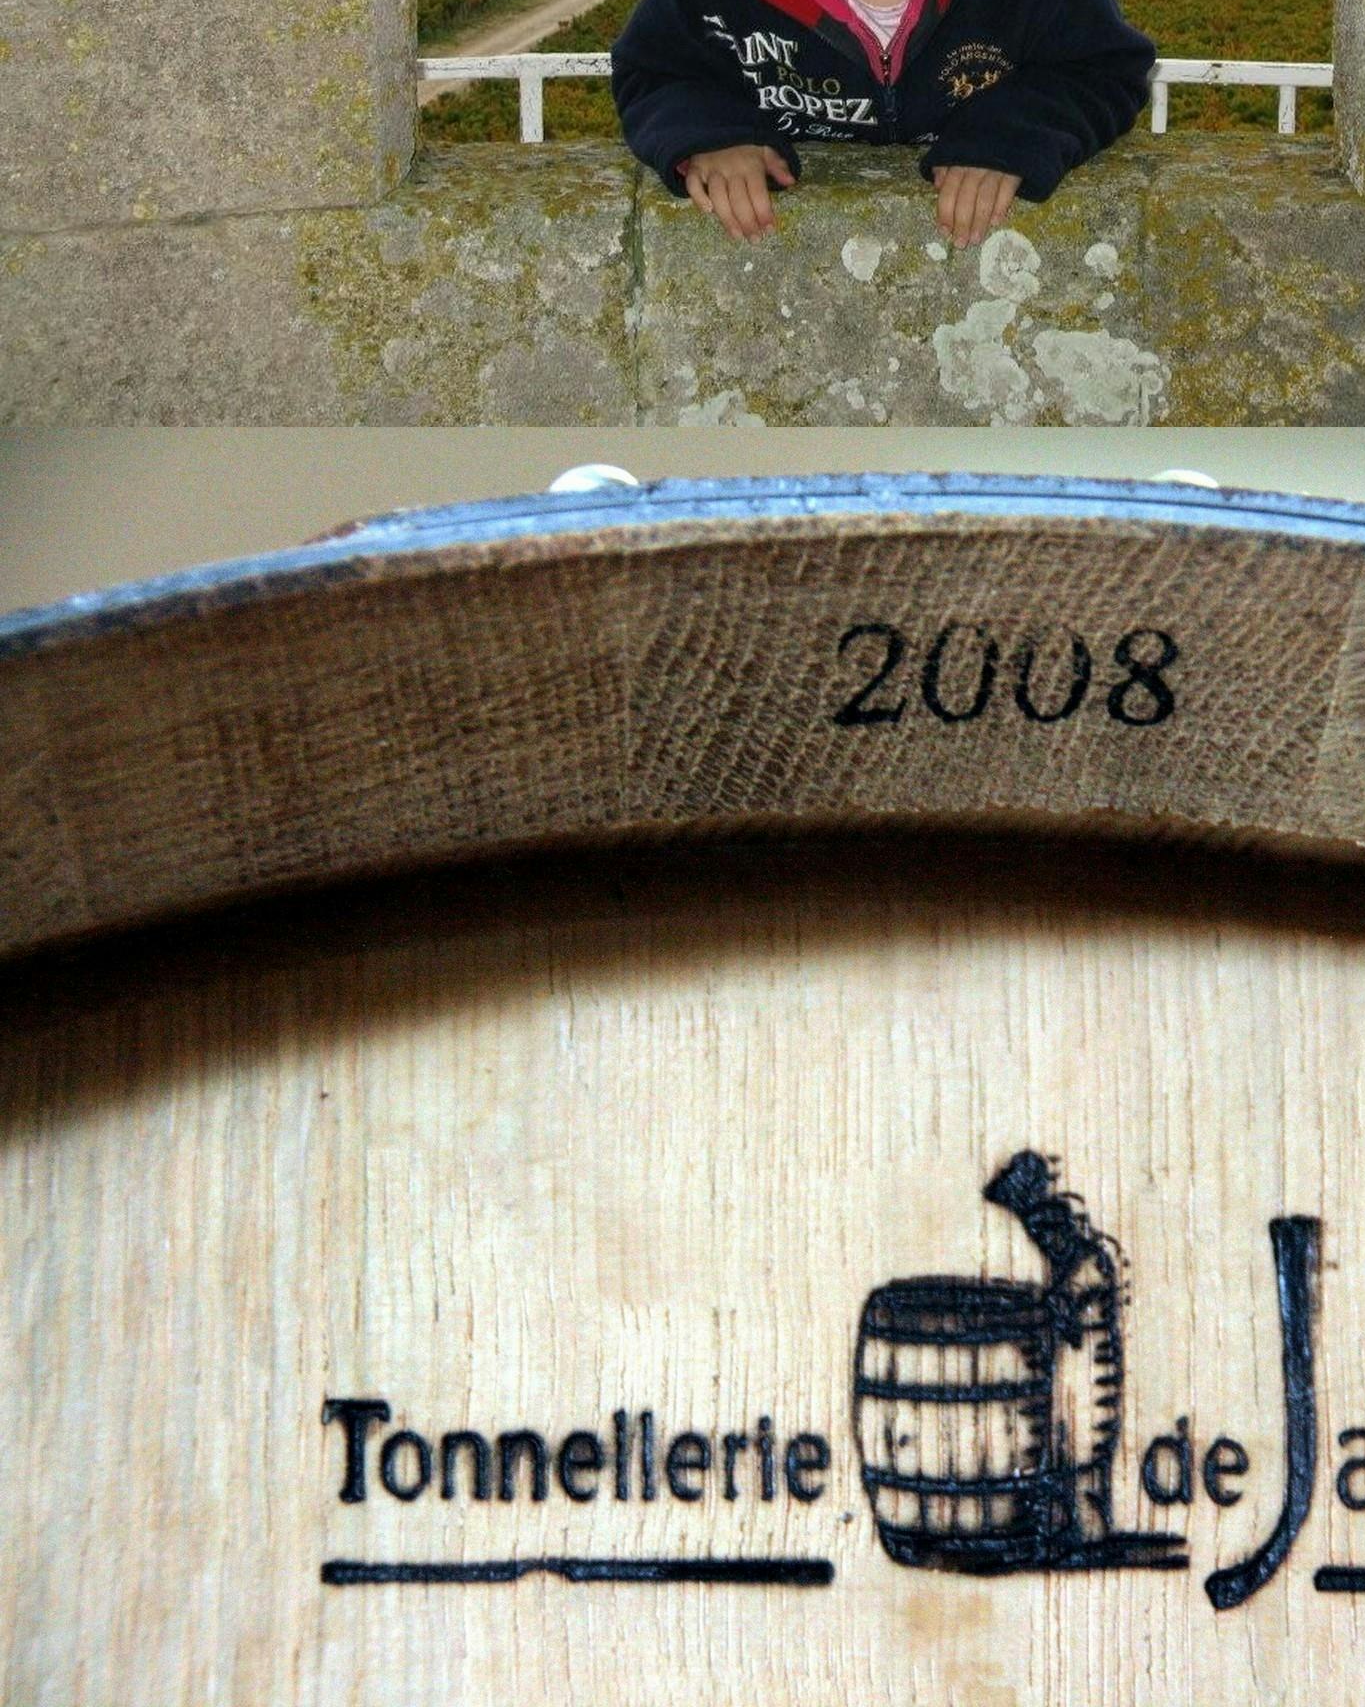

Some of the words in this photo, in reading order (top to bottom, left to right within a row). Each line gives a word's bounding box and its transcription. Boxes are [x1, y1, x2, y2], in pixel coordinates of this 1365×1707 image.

[777, 66, 841, 96] POLO
[833, 621, 1179, 726] 2008
[321, 1398, 829, 1508] Tonnellerie
[1140, 1415, 1250, 1508] de
